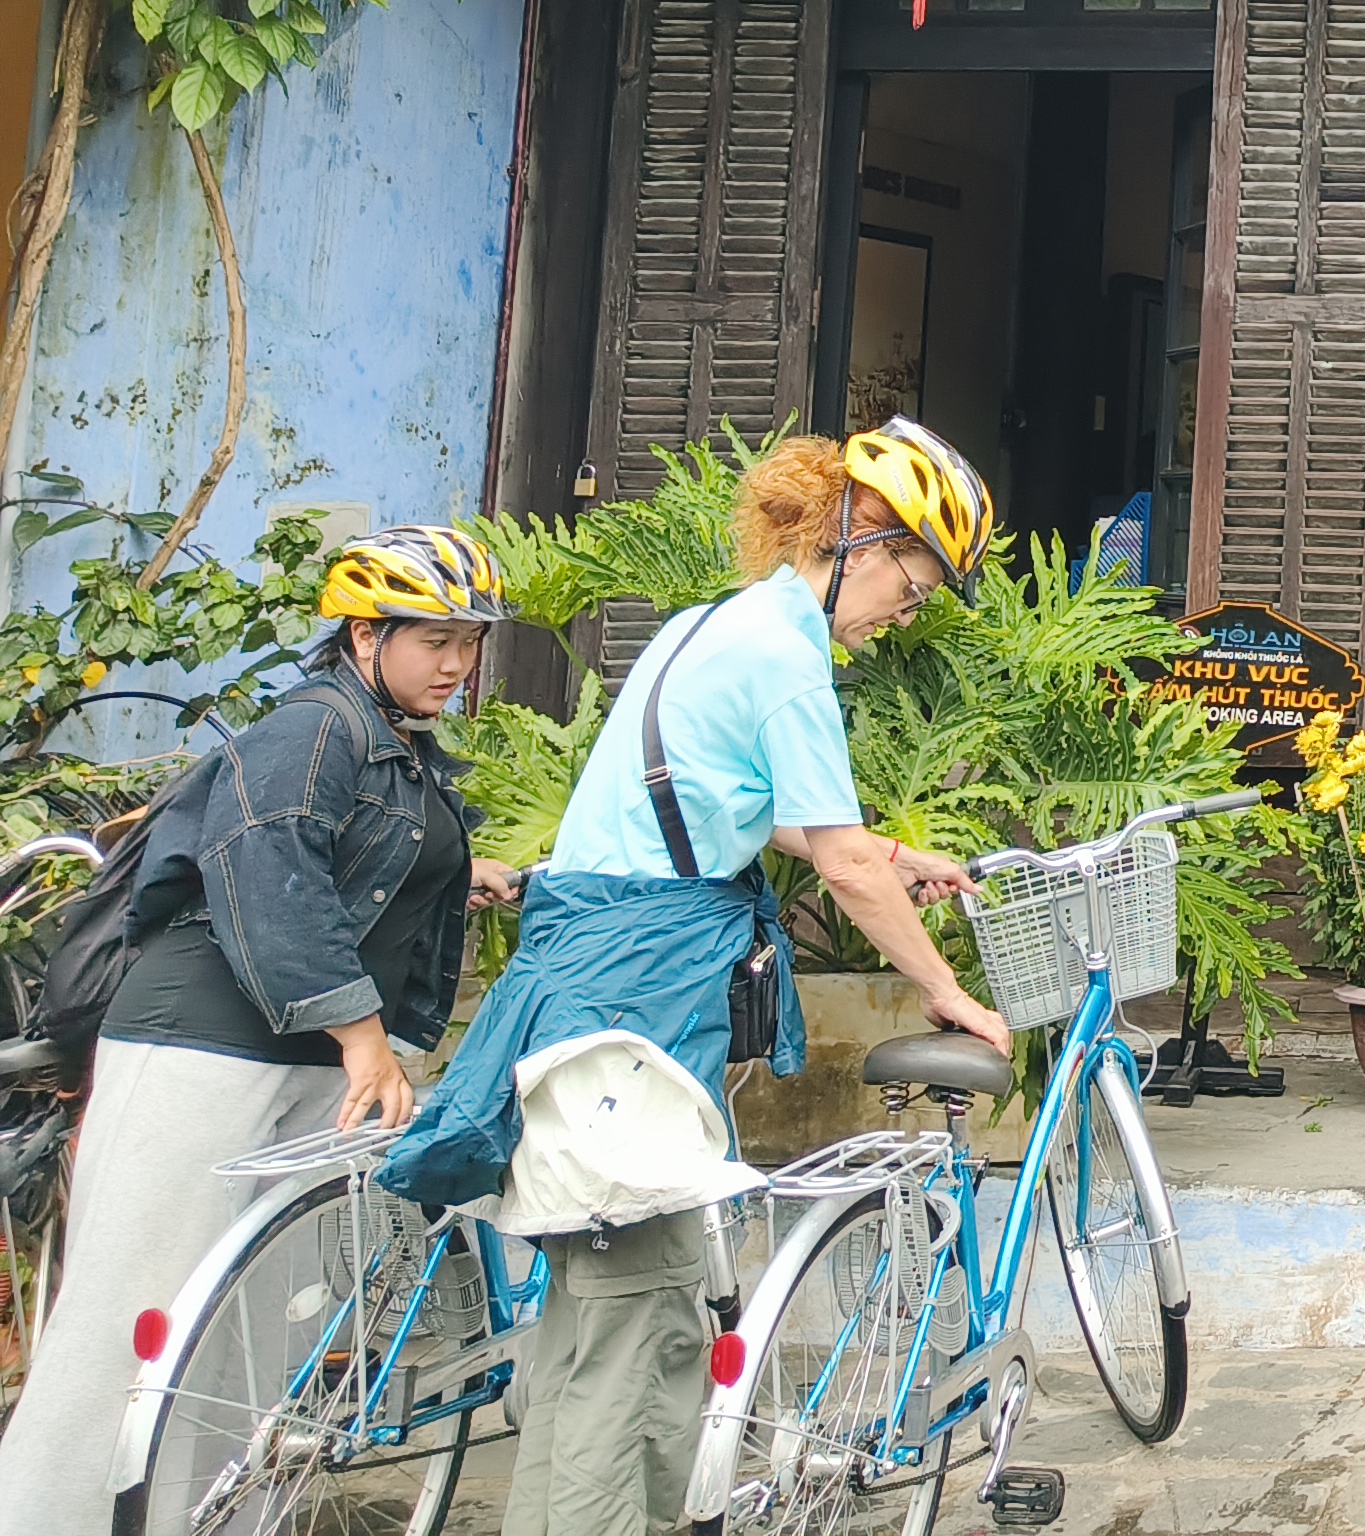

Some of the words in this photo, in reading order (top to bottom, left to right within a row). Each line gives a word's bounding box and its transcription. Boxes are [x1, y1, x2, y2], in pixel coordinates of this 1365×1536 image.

[1264, 631, 1301, 647] AN
[1203, 649, 1234, 660] KHÔNG
[1173, 660, 1237, 680] KHU
[1248, 664, 1310, 687] VỰC
[1139, 675, 1192, 700] ẤM
[1201, 682, 1251, 705] HÚT
[1260, 685, 1339, 710] THUỐC
[1203, 706, 1259, 724] OKING
[1260, 710, 1305, 726] AREA
